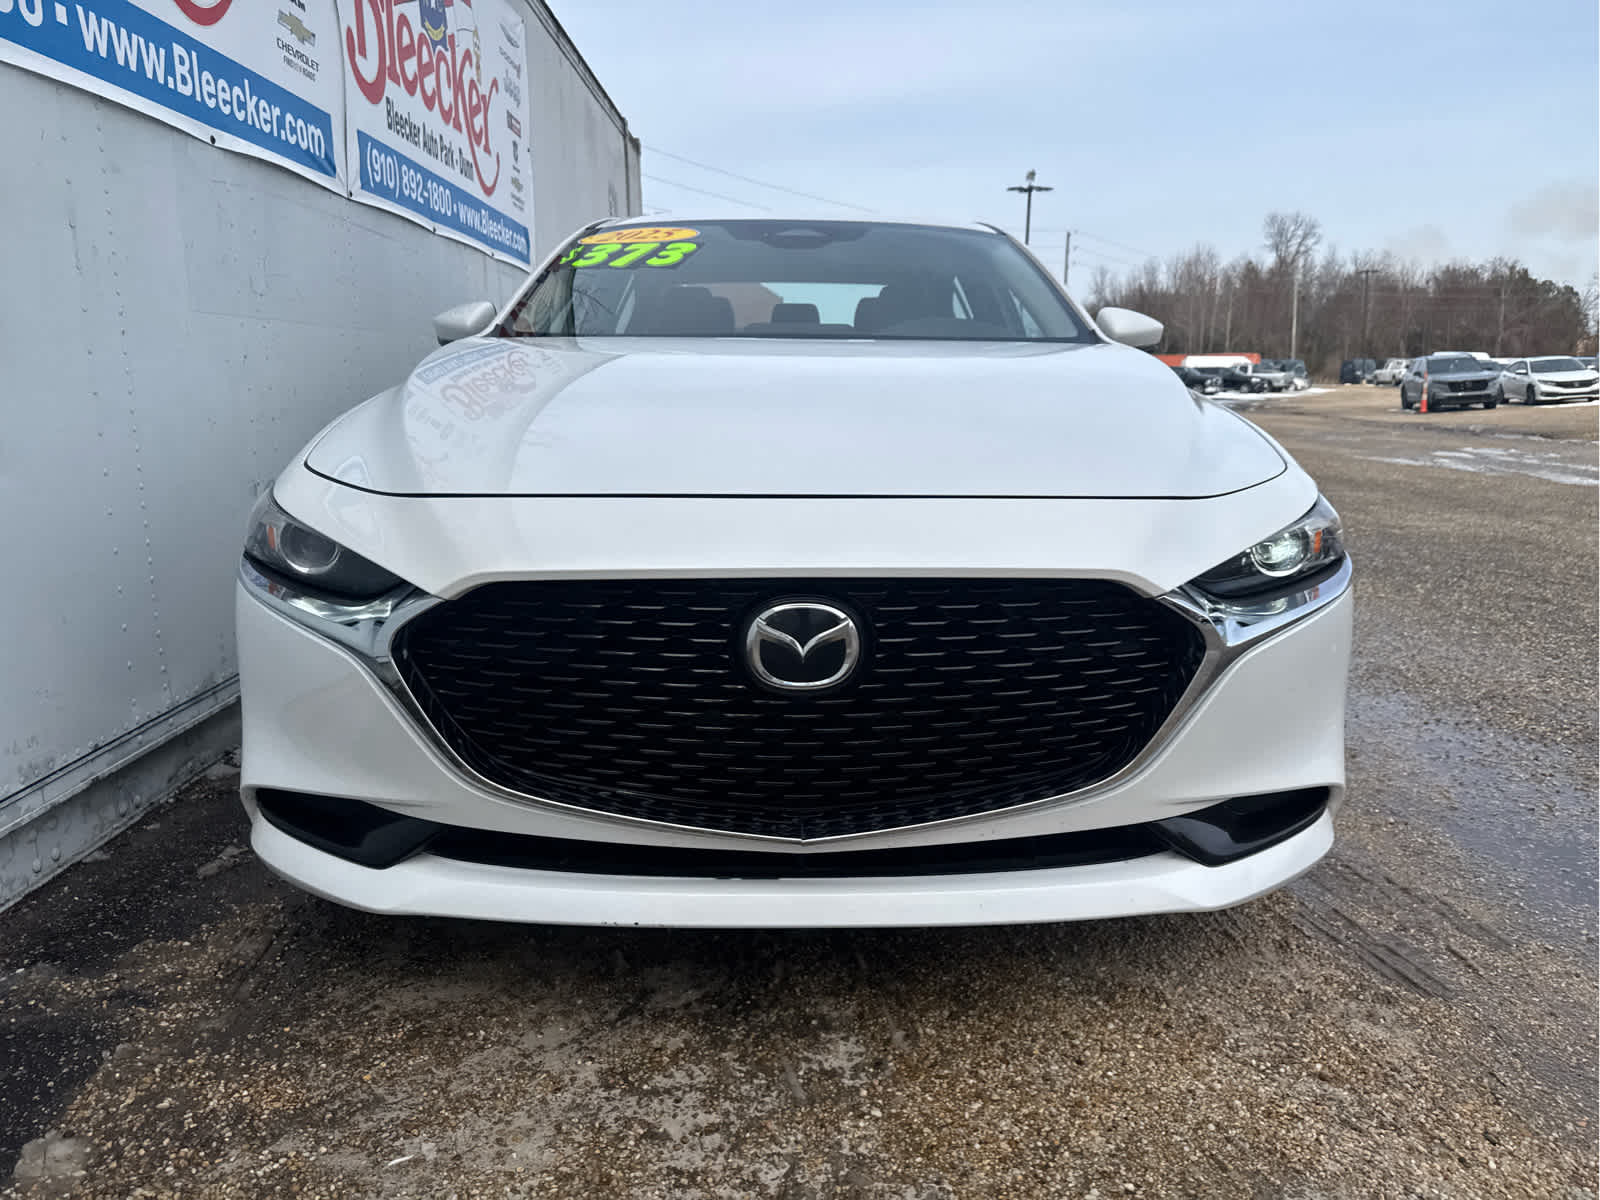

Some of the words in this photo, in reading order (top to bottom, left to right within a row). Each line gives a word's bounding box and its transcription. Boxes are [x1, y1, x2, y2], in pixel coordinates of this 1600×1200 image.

[75, 3, 326, 159] www.Bleecker.com
[276, 37, 319, 73] CHEVROLET
[385, 96, 421, 150] Bleecker
[422, 121, 438, 161] Auto
[440, 134, 455, 171] Park
[367, 142, 400, 200] (910)
[401, 163, 453, 217] 892-1800
[458, 201, 528, 255] www.Bleecker.com
[559, 242, 697, 268] $373
